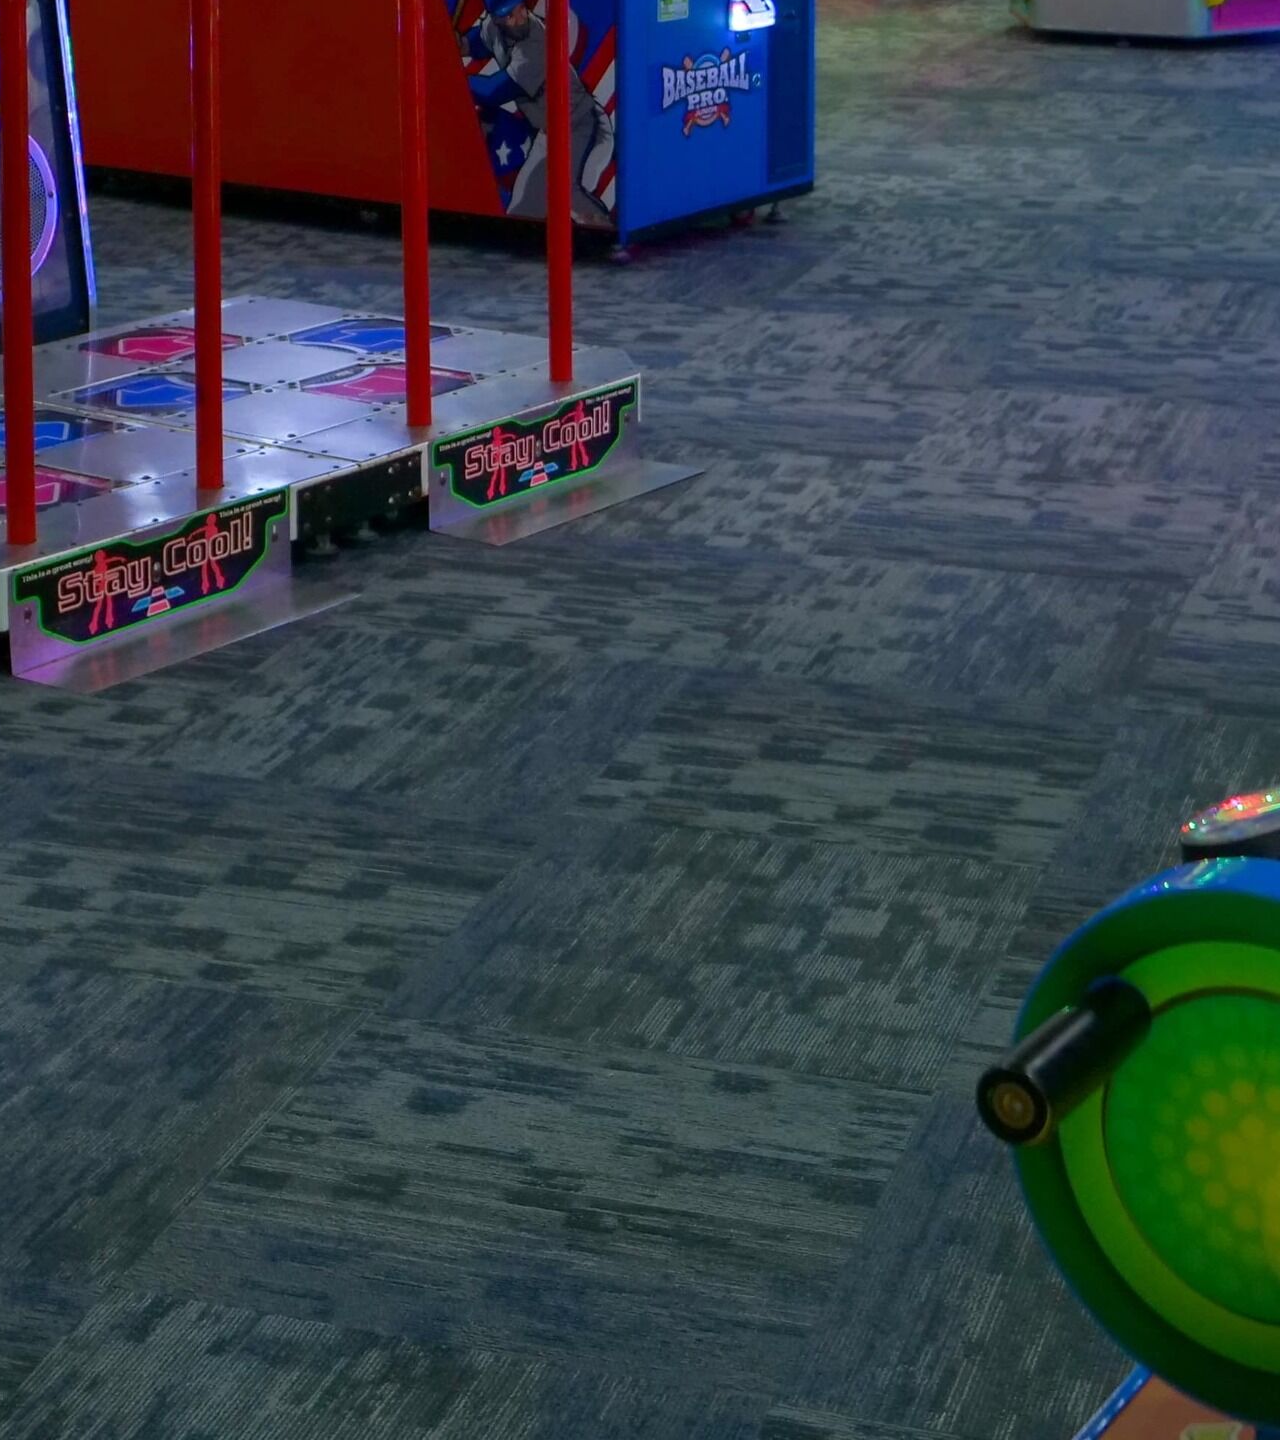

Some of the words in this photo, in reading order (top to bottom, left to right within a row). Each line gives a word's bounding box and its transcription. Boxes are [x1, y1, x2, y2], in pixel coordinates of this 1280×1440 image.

[662, 52, 749, 109] BASEBALL
[465, 435, 534, 479] Stay
[543, 400, 611, 453] Cool!
[58, 555, 151, 613] Stay
[164, 512, 253, 575] Cool!
